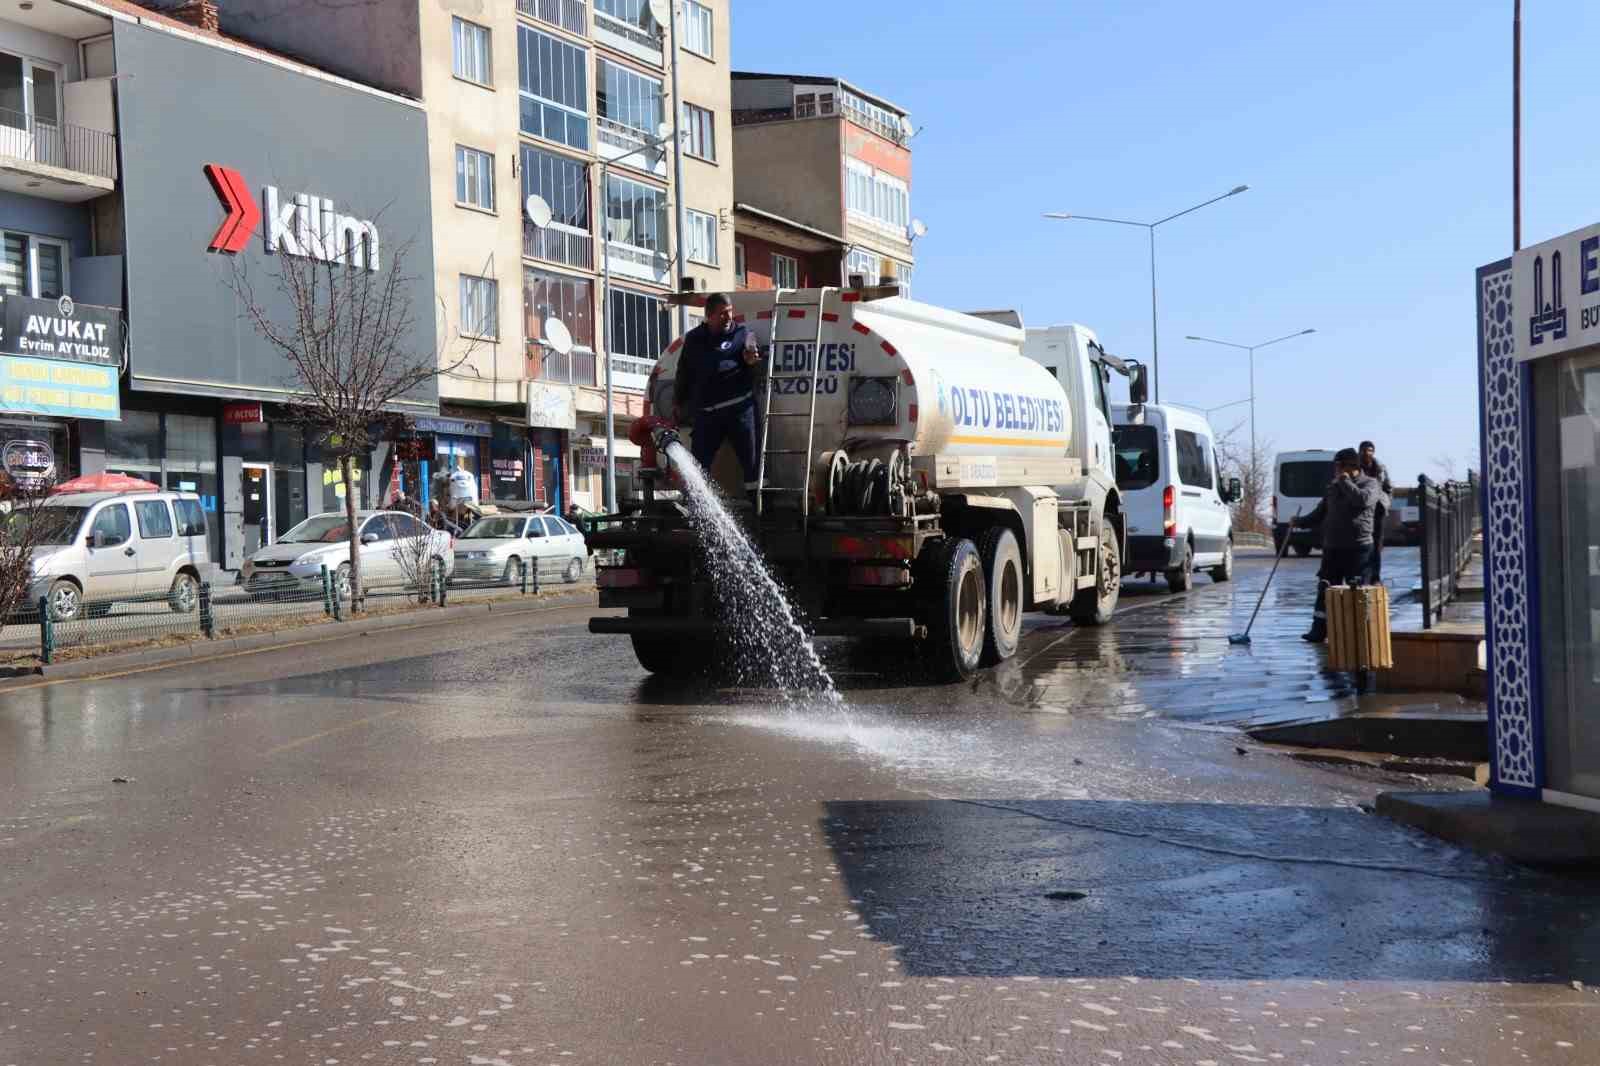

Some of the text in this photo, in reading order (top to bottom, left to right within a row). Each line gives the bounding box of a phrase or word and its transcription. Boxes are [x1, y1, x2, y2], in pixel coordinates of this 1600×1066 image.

[263, 185, 379, 271] kilim
[26, 314, 106, 341] AVUKAT
[19, 336, 110, 358] Evrim AYYILDIZ
[951, 385, 991, 428] OLTU
